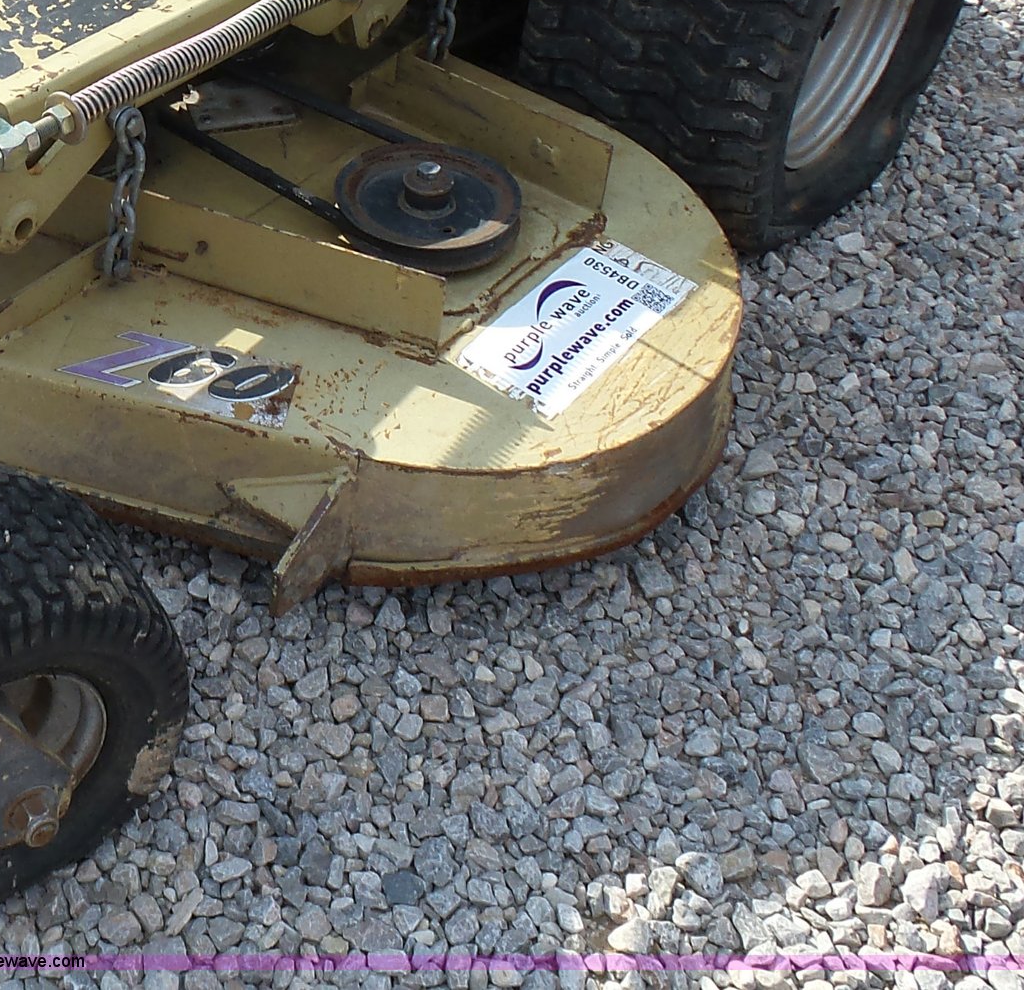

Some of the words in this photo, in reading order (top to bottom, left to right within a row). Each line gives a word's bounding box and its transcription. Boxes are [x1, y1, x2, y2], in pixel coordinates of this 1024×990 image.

[575, 294, 600, 318] auction
[584, 257, 640, 291] DB4530
[504, 320, 553, 364] purple
[550, 285, 591, 321] wave
[526, 297, 635, 395] purplewave.com
[567, 364, 598, 391] Straight
[596, 341, 622, 364] Simple
[620, 326, 638, 342] Sold
